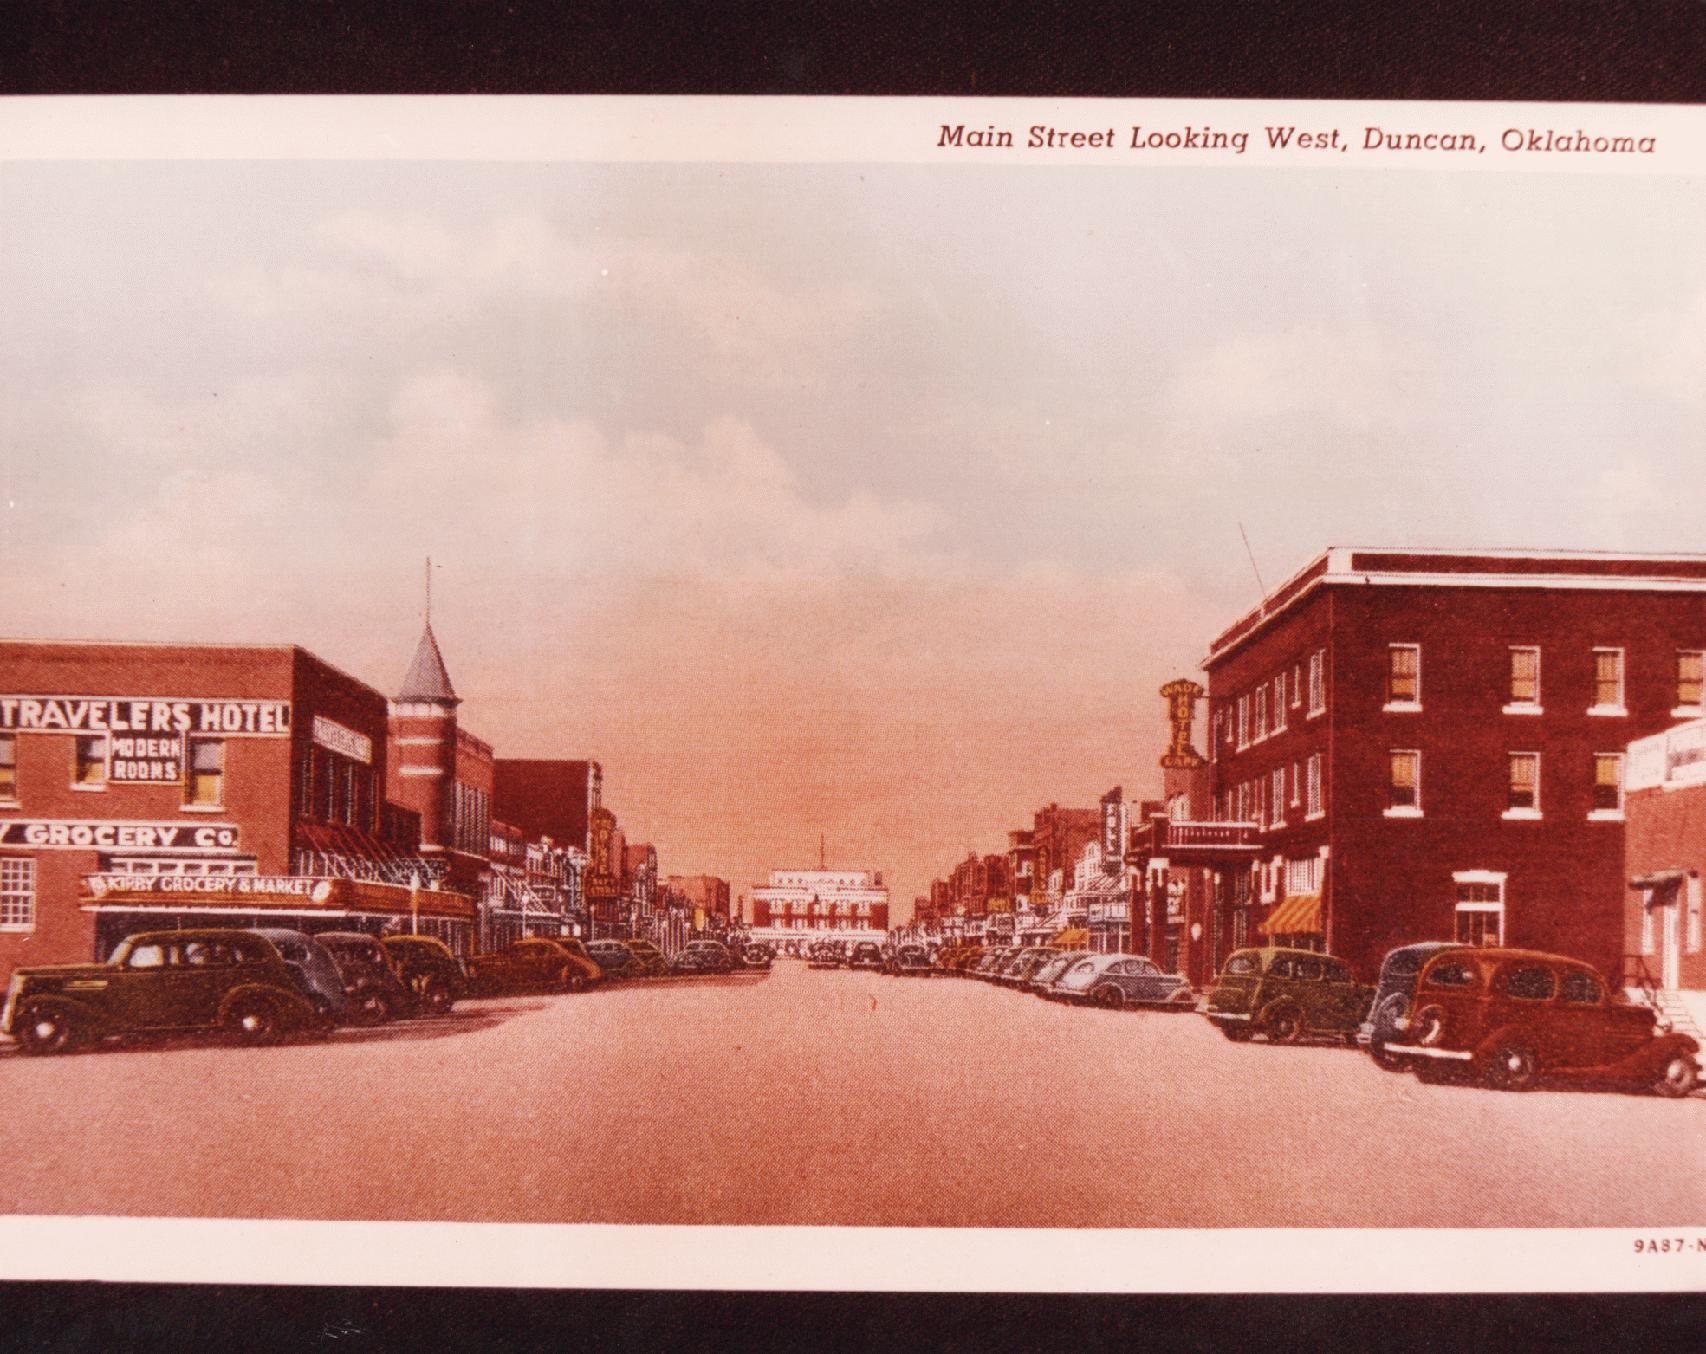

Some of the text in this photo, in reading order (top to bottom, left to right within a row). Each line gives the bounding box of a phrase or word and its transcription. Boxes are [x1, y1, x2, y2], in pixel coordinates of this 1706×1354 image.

[2, 699, 289, 732] TRAVELERS HOTEL
[112, 738, 180, 757] MODERN
[113, 761, 177, 779] ROOMS
[24, 825, 178, 846] GROCERY
[108, 877, 313, 895] KIRBY GROCERY & MARKET
